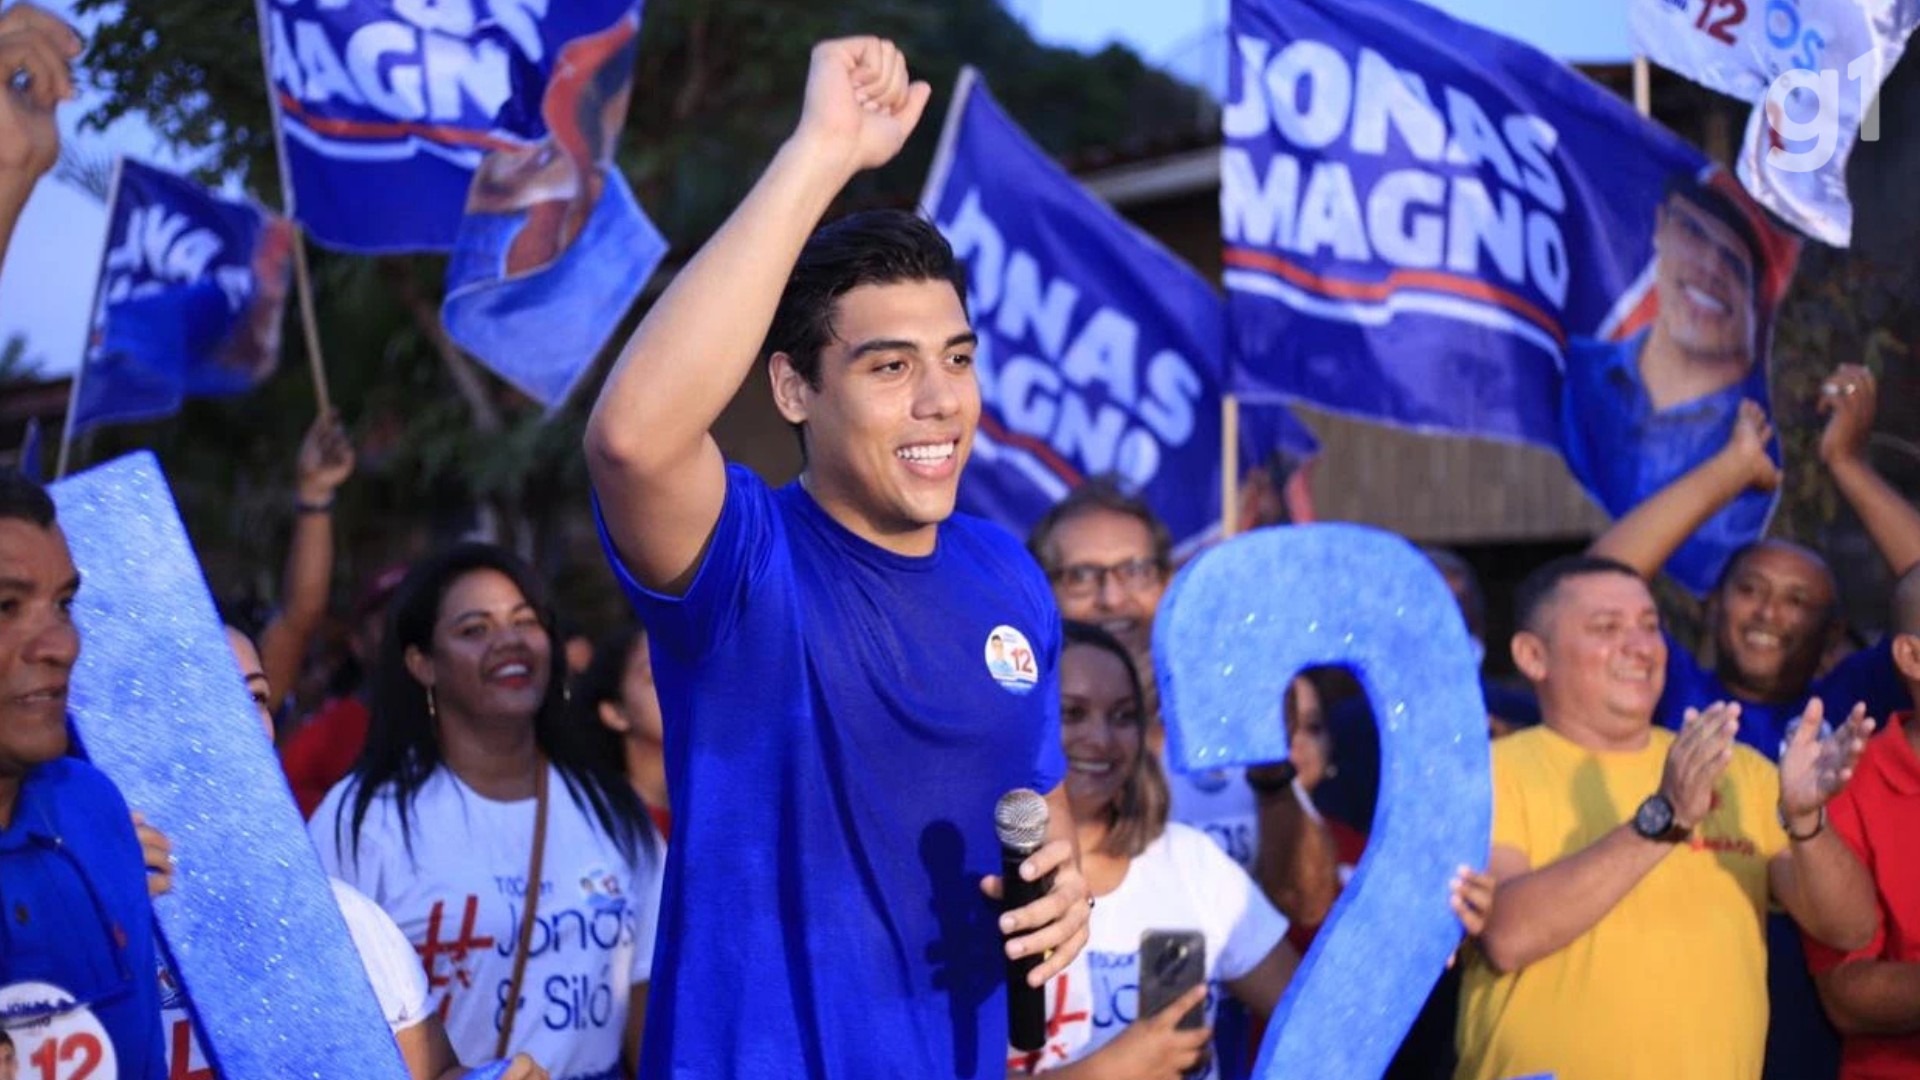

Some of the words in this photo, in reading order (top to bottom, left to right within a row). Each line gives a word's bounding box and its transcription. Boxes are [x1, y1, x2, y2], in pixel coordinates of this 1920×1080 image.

[1221, 33, 1566, 214] JONAS
[1219, 146, 1570, 311] MAGNO
[1011, 647, 1033, 674] 12
[30, 1031, 102, 1080] 12
